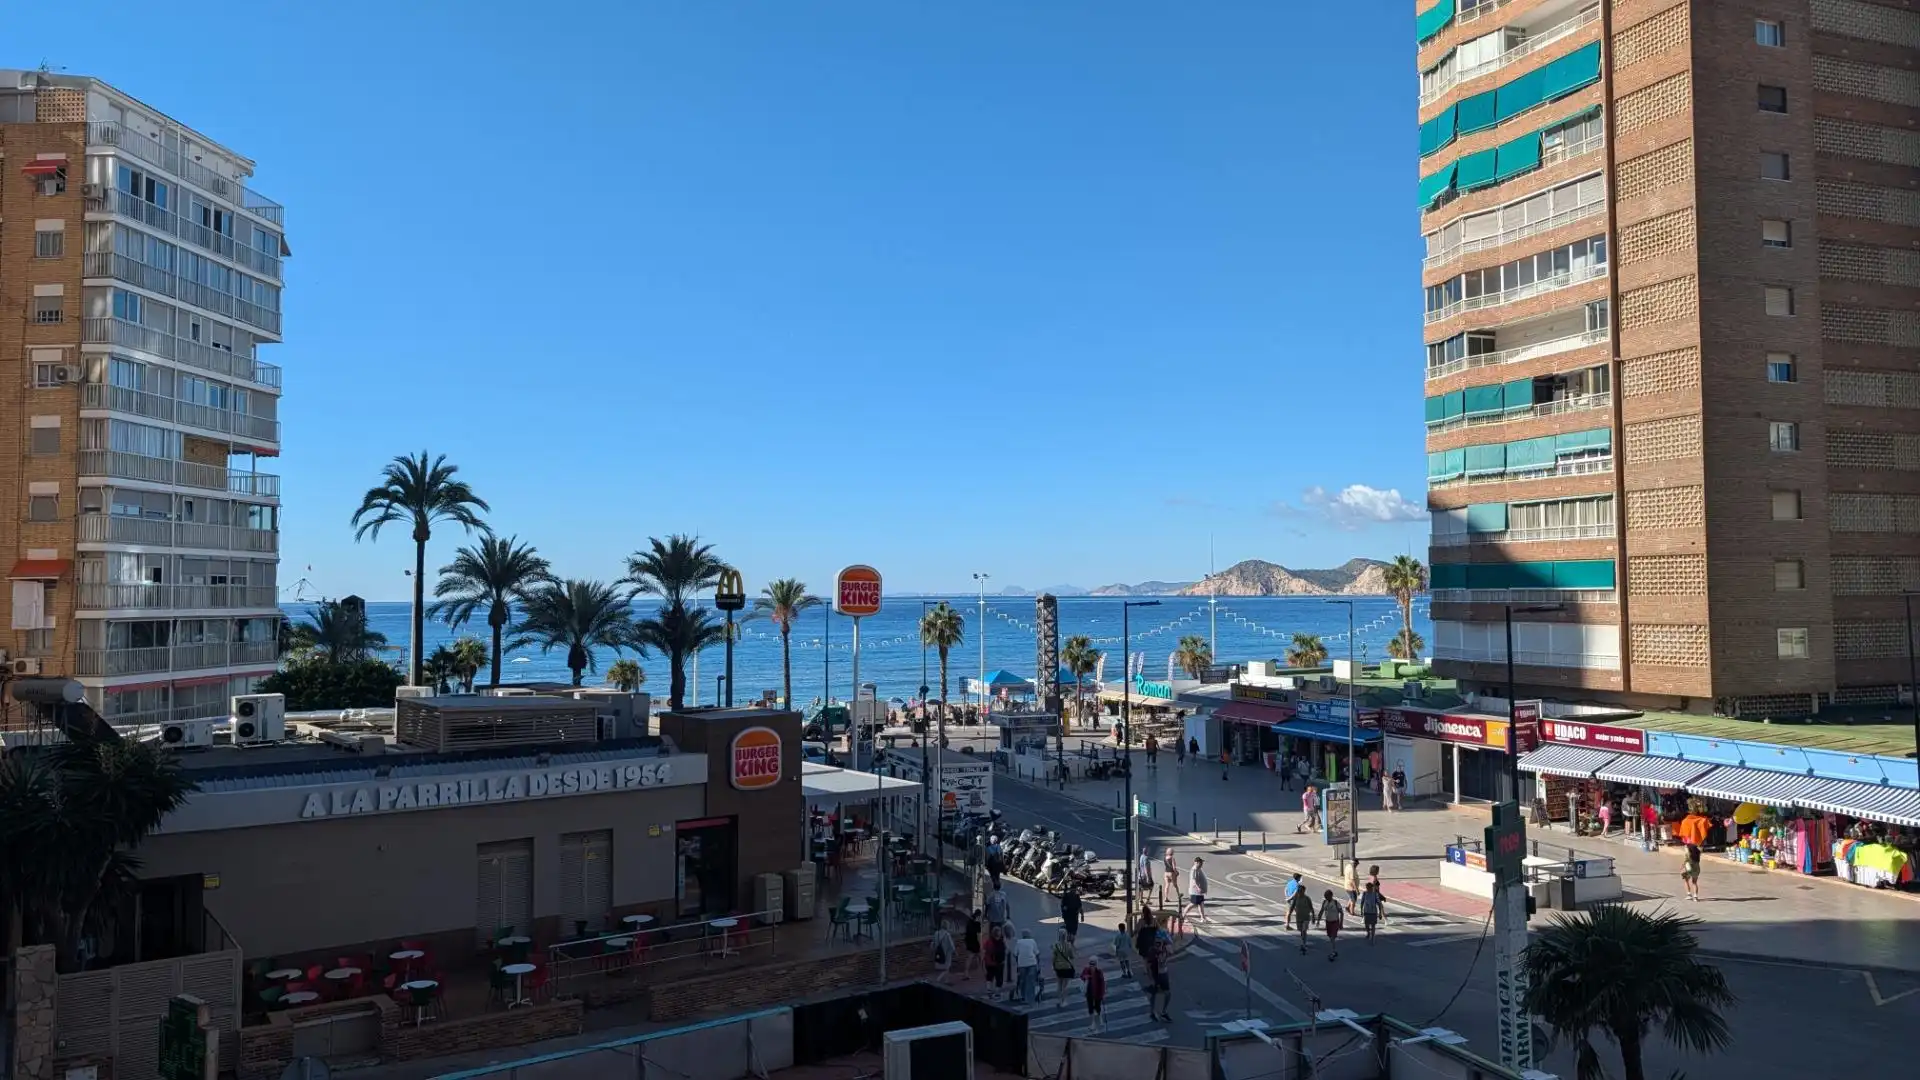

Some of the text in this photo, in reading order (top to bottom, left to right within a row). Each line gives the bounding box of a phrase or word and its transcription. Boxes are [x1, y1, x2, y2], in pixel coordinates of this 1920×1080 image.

[840, 581, 879, 592] BURGER
[840, 591, 880, 606] KING
[1554, 723, 1586, 740] UDACO
[735, 746, 779, 760] BURGER
[735, 758, 778, 777] KING
[302, 763, 674, 818] A LA PARRILLA DESDE 1954
[1499, 970, 1512, 1068] ARMACIA
[1514, 971, 1530, 1069] ARMACIA
